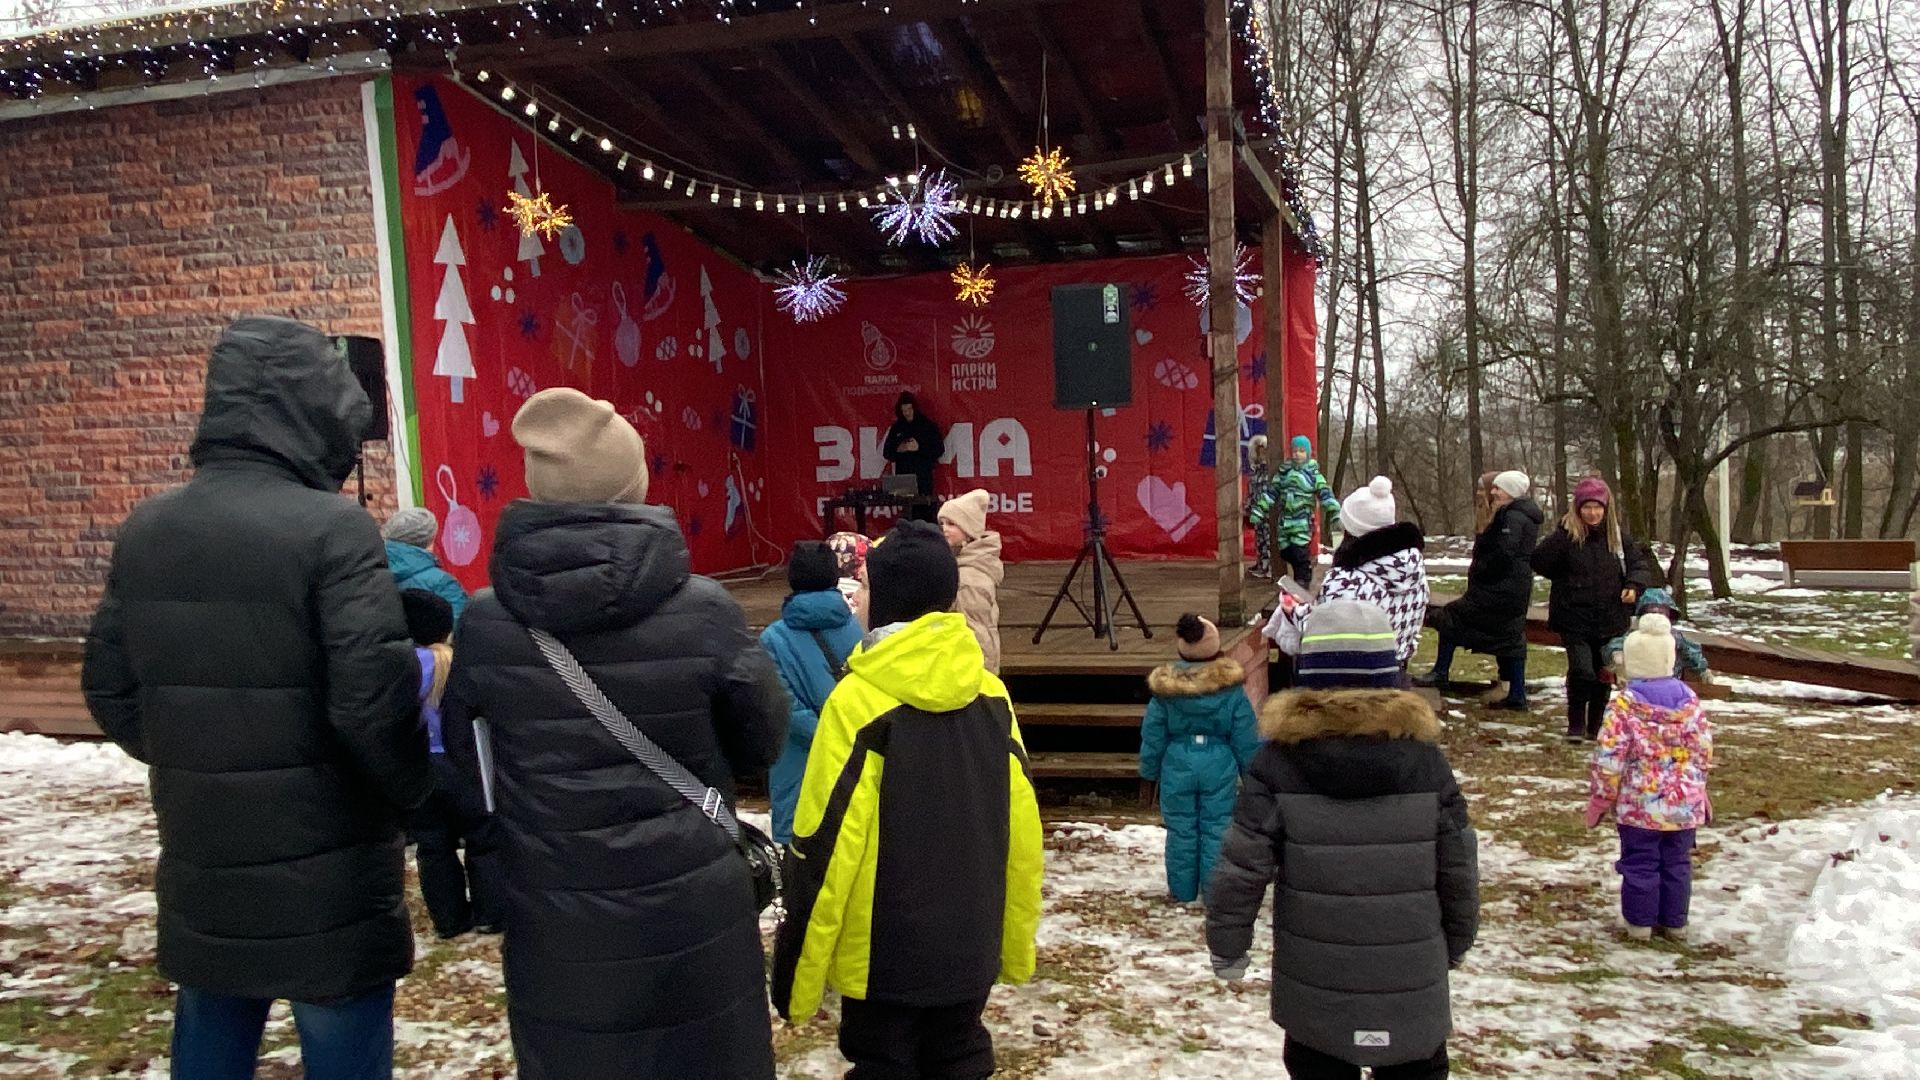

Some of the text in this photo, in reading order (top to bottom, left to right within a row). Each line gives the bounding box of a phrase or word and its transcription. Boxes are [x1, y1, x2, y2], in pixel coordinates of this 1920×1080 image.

[951, 362, 996, 377] ПАРКИ
[864, 375, 898, 385] ПАРКИ
[951, 376, 997, 392] ИСТРЫ
